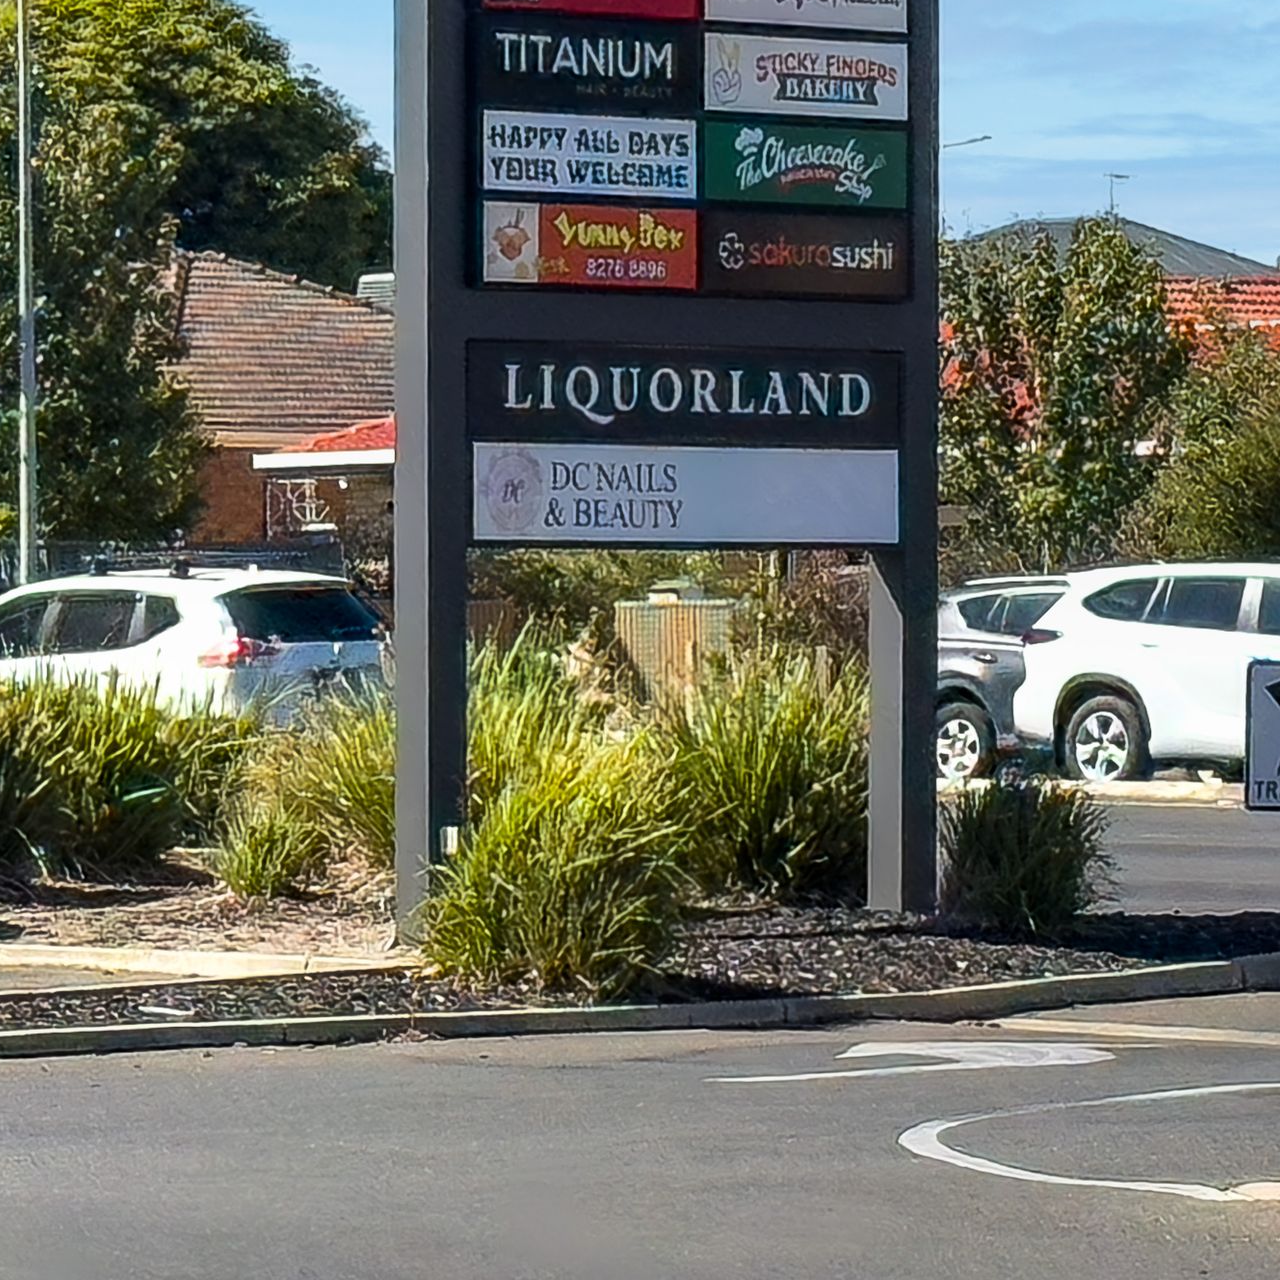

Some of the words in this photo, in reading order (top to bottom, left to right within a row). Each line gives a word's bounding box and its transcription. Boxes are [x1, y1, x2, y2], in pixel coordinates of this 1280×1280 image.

[496, 32, 673, 79] TITANIUM
[756, 52, 819, 82] STICKY
[826, 54, 897, 87] FINGERS
[786, 78, 868, 100] BAKERY
[488, 124, 567, 150] HAPPY
[574, 129, 620, 154] ALL
[628, 131, 690, 157] DAYS
[490, 157, 558, 185] YOUR
[567, 159, 690, 188] WELCOME
[736, 156, 762, 190] The
[762, 136, 866, 178] Cheesecake
[504, 363, 871, 425] LIQUORLAND
[551, 461, 590, 491] DC
[595, 463, 678, 493] NAILS
[543, 497, 566, 527] &
[573, 499, 683, 528] BEAUTY
